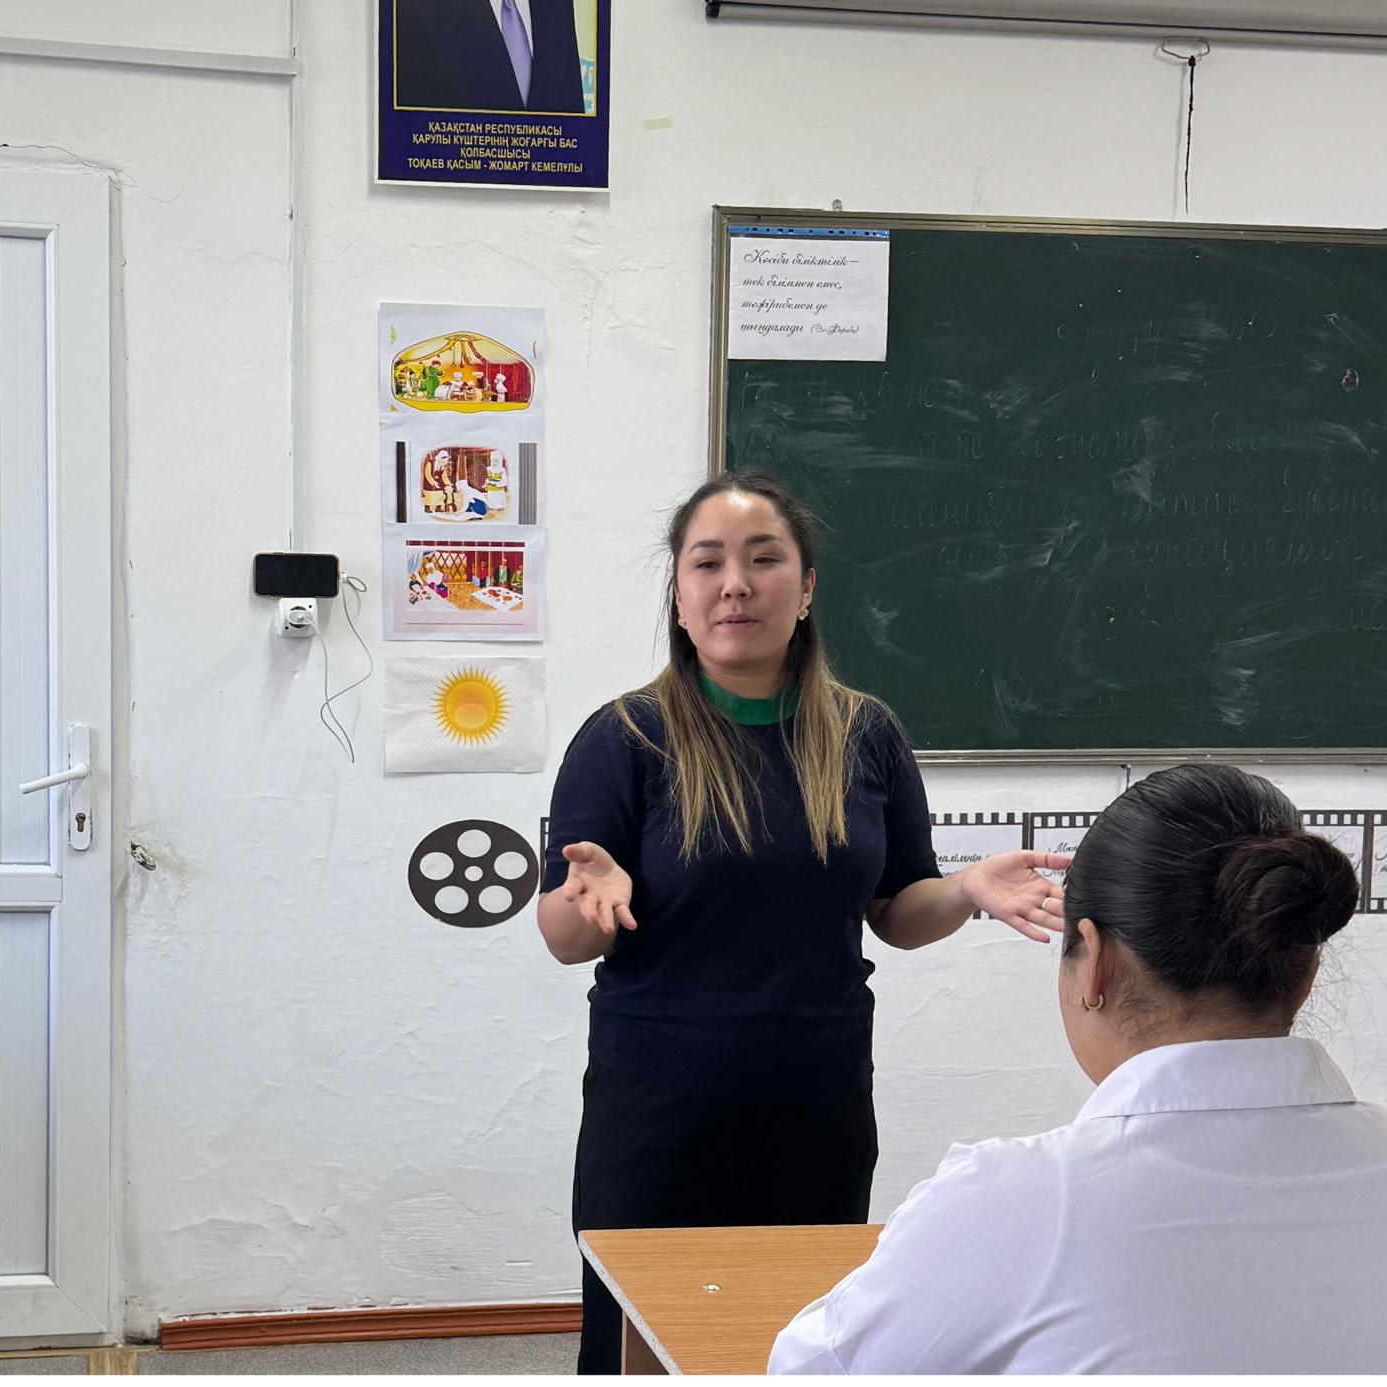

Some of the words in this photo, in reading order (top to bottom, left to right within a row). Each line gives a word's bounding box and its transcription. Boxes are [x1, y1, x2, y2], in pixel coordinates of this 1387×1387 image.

[429, 122, 482, 133] ҚАЗАҚСТАН
[485, 124, 562, 135] РЕСПУБЛИКАСЫ
[413, 134, 451, 144] ҚАРУЛЫ
[453, 135, 508, 147] КҮШТЕРІНІҢ
[511, 137, 557, 148] ЖОҒАРҒЫ
[560, 139, 577, 148] БАС
[460, 148, 530, 158] ҚОЛБАСШЫСЫ
[408, 158, 444, 169] ТОҚАЕВ
[447, 159, 481, 170] ҚАСЫМ
[489, 160, 528, 171] ЖОМАРТ
[531, 162, 582, 172] КЕМЕЛҰЛЫ
